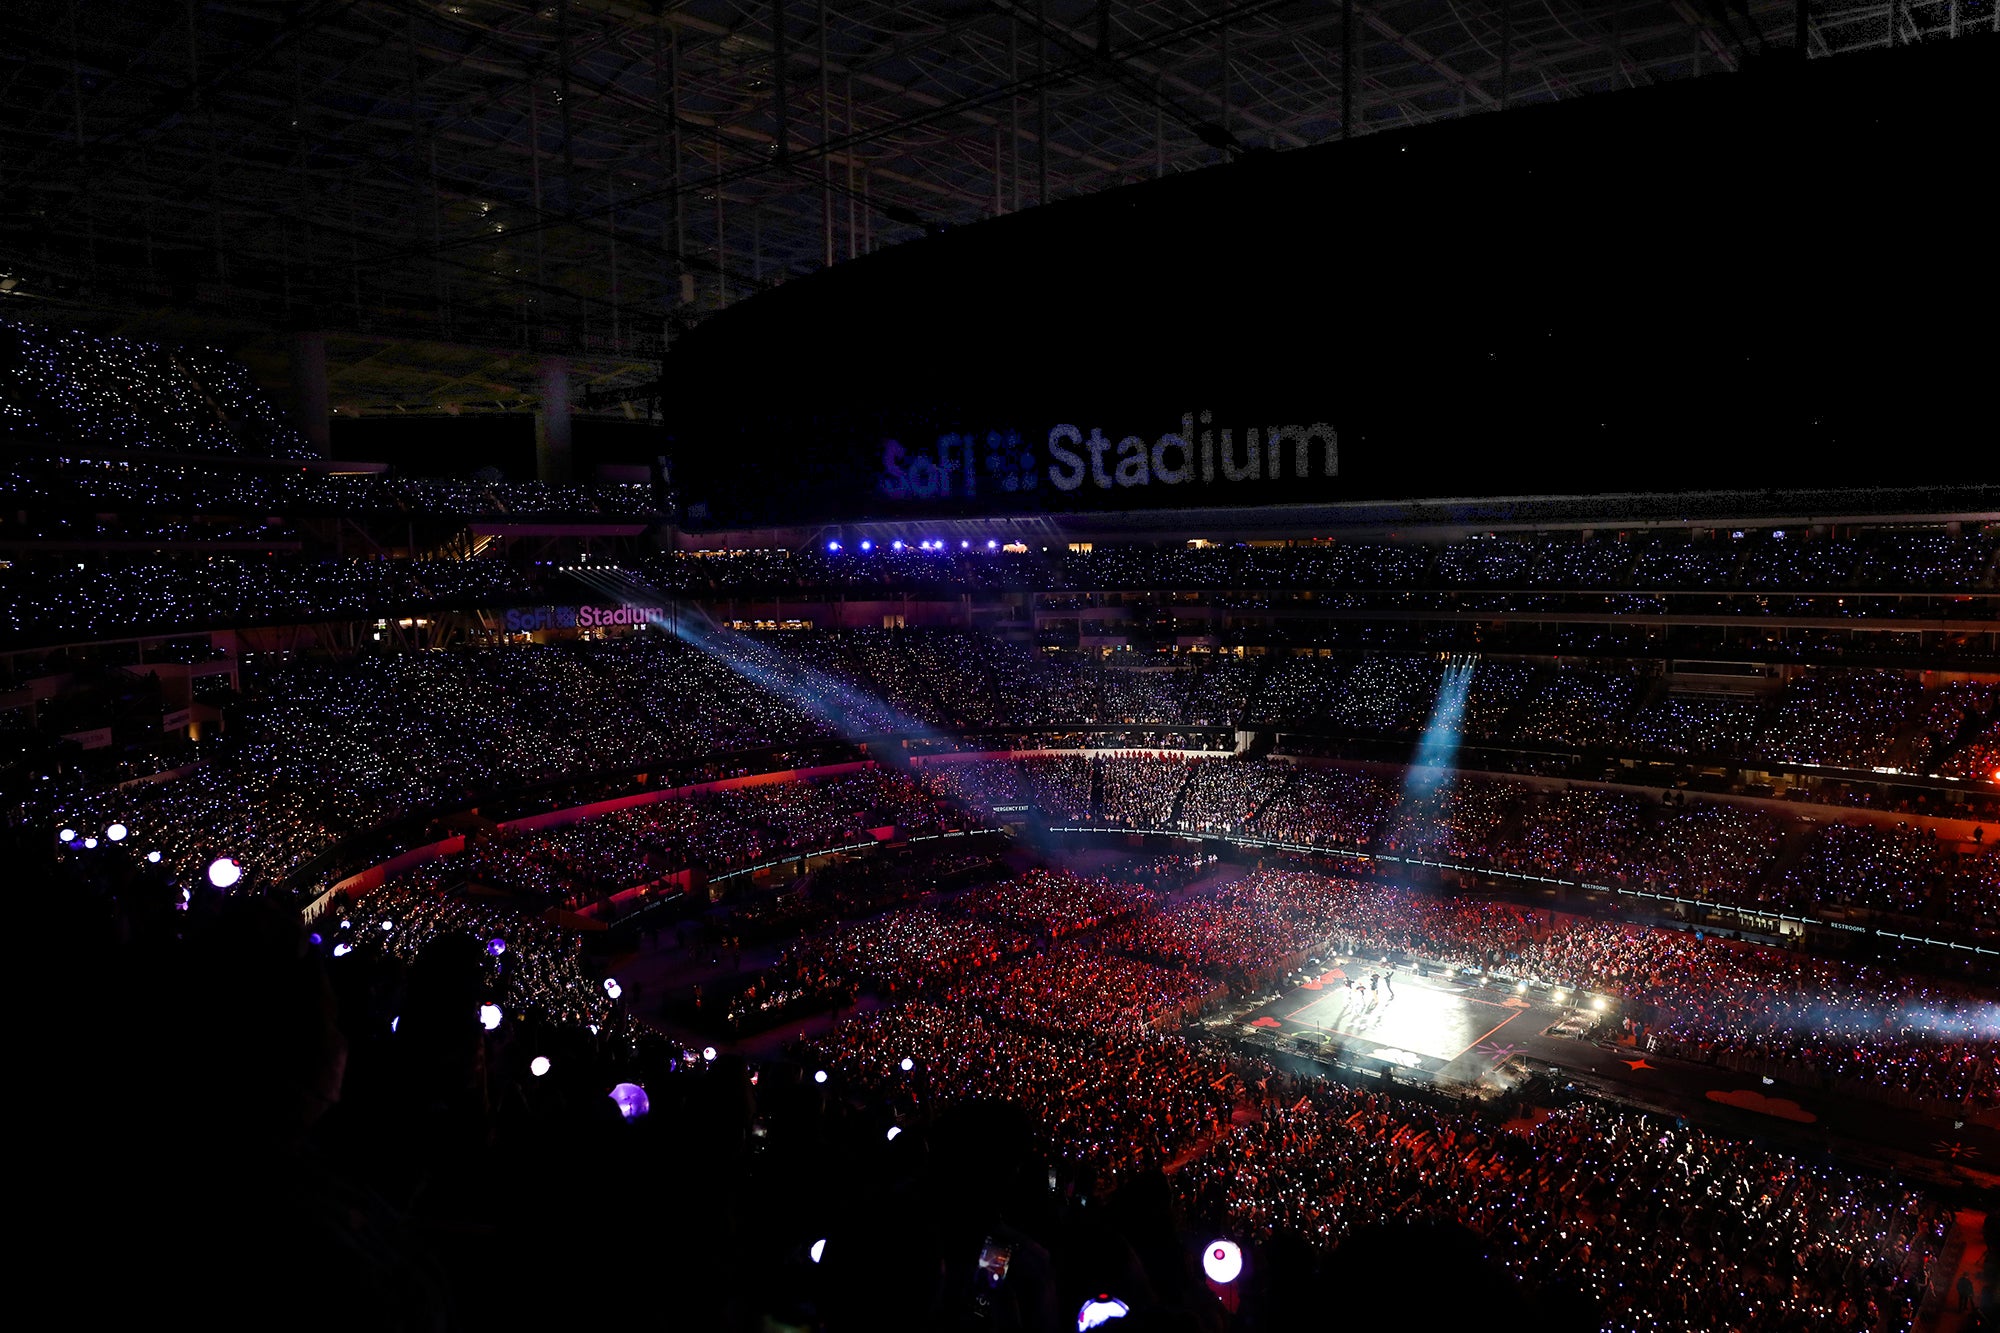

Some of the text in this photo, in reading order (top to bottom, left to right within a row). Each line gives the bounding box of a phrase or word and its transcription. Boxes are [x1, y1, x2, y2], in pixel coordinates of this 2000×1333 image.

[1047, 409, 1339, 492] Stadium
[579, 603, 664, 626] Stadium
[1375, 854, 1400, 862] RESTROOMS
[1581, 883, 1610, 892] RESTROOMS
[1830, 921, 1866, 934] RESTROOMS
